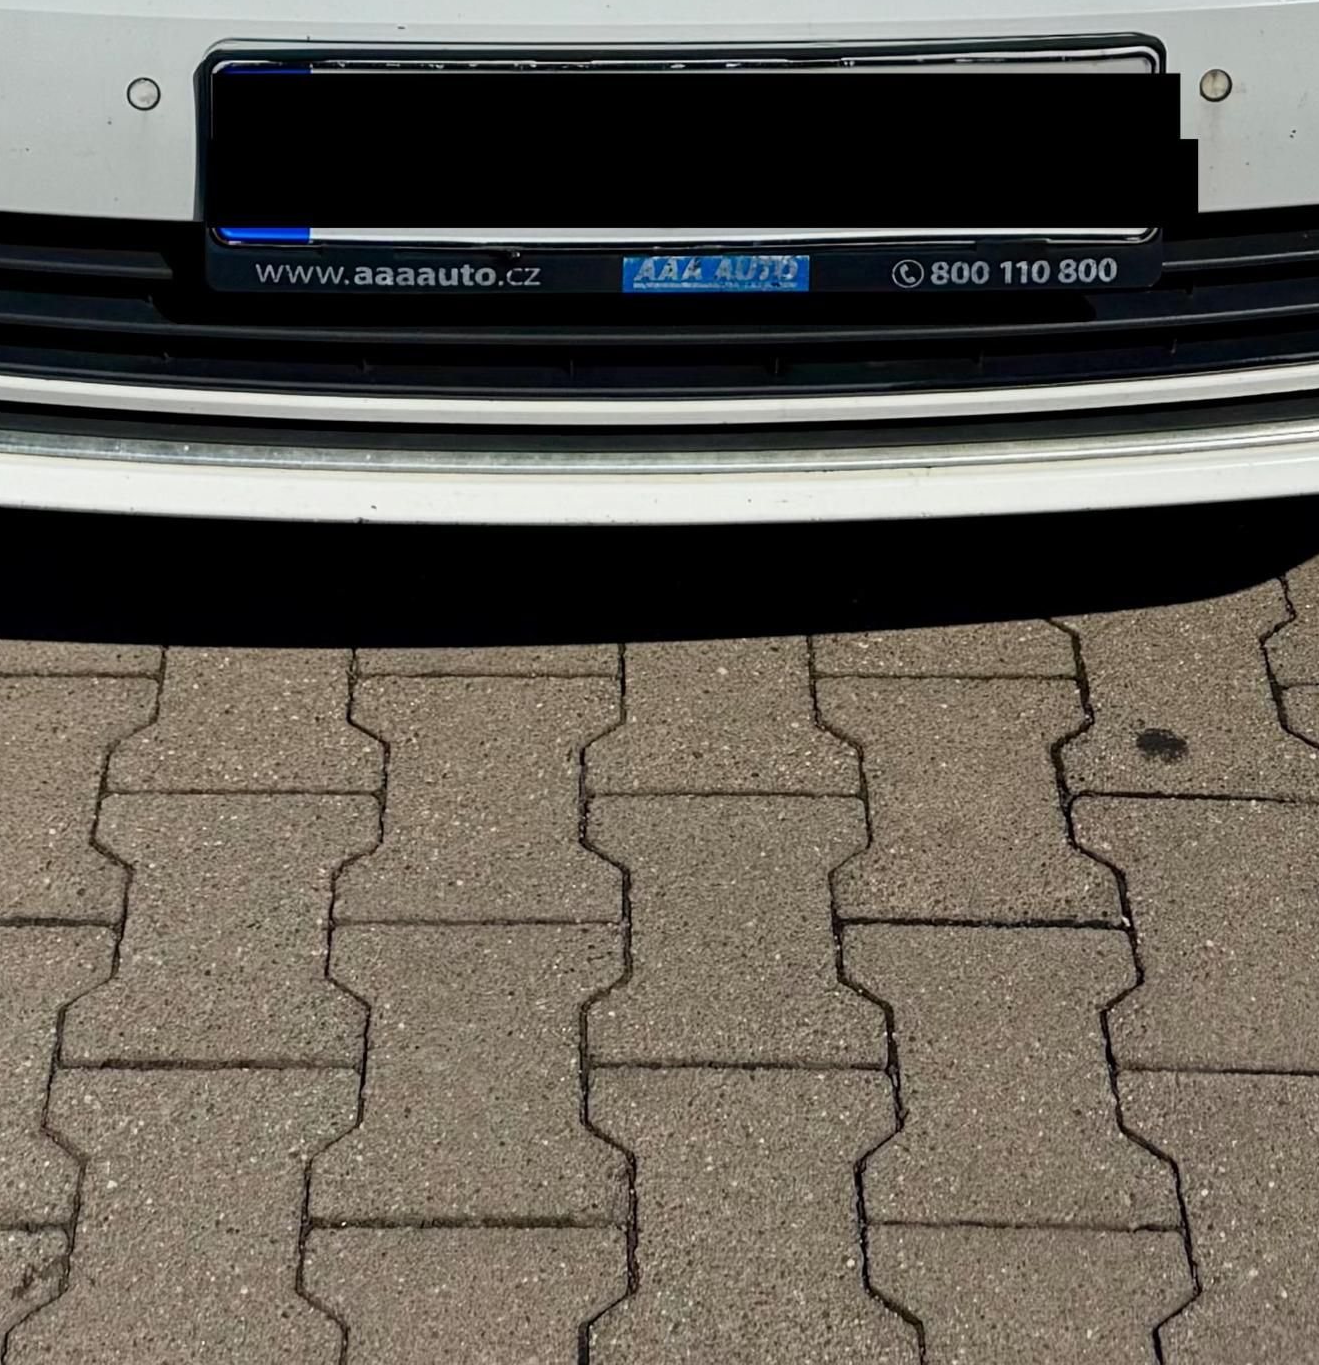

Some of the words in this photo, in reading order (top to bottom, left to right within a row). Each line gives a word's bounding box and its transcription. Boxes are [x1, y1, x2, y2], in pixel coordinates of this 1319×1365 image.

[255, 263, 541, 286] www.aaaauto.cz
[633, 258, 702, 281] AAA
[715, 256, 799, 281] AUTO
[931, 261, 990, 285] 800
[1000, 260, 1051, 284] 110
[1058, 257, 1118, 283] 800
